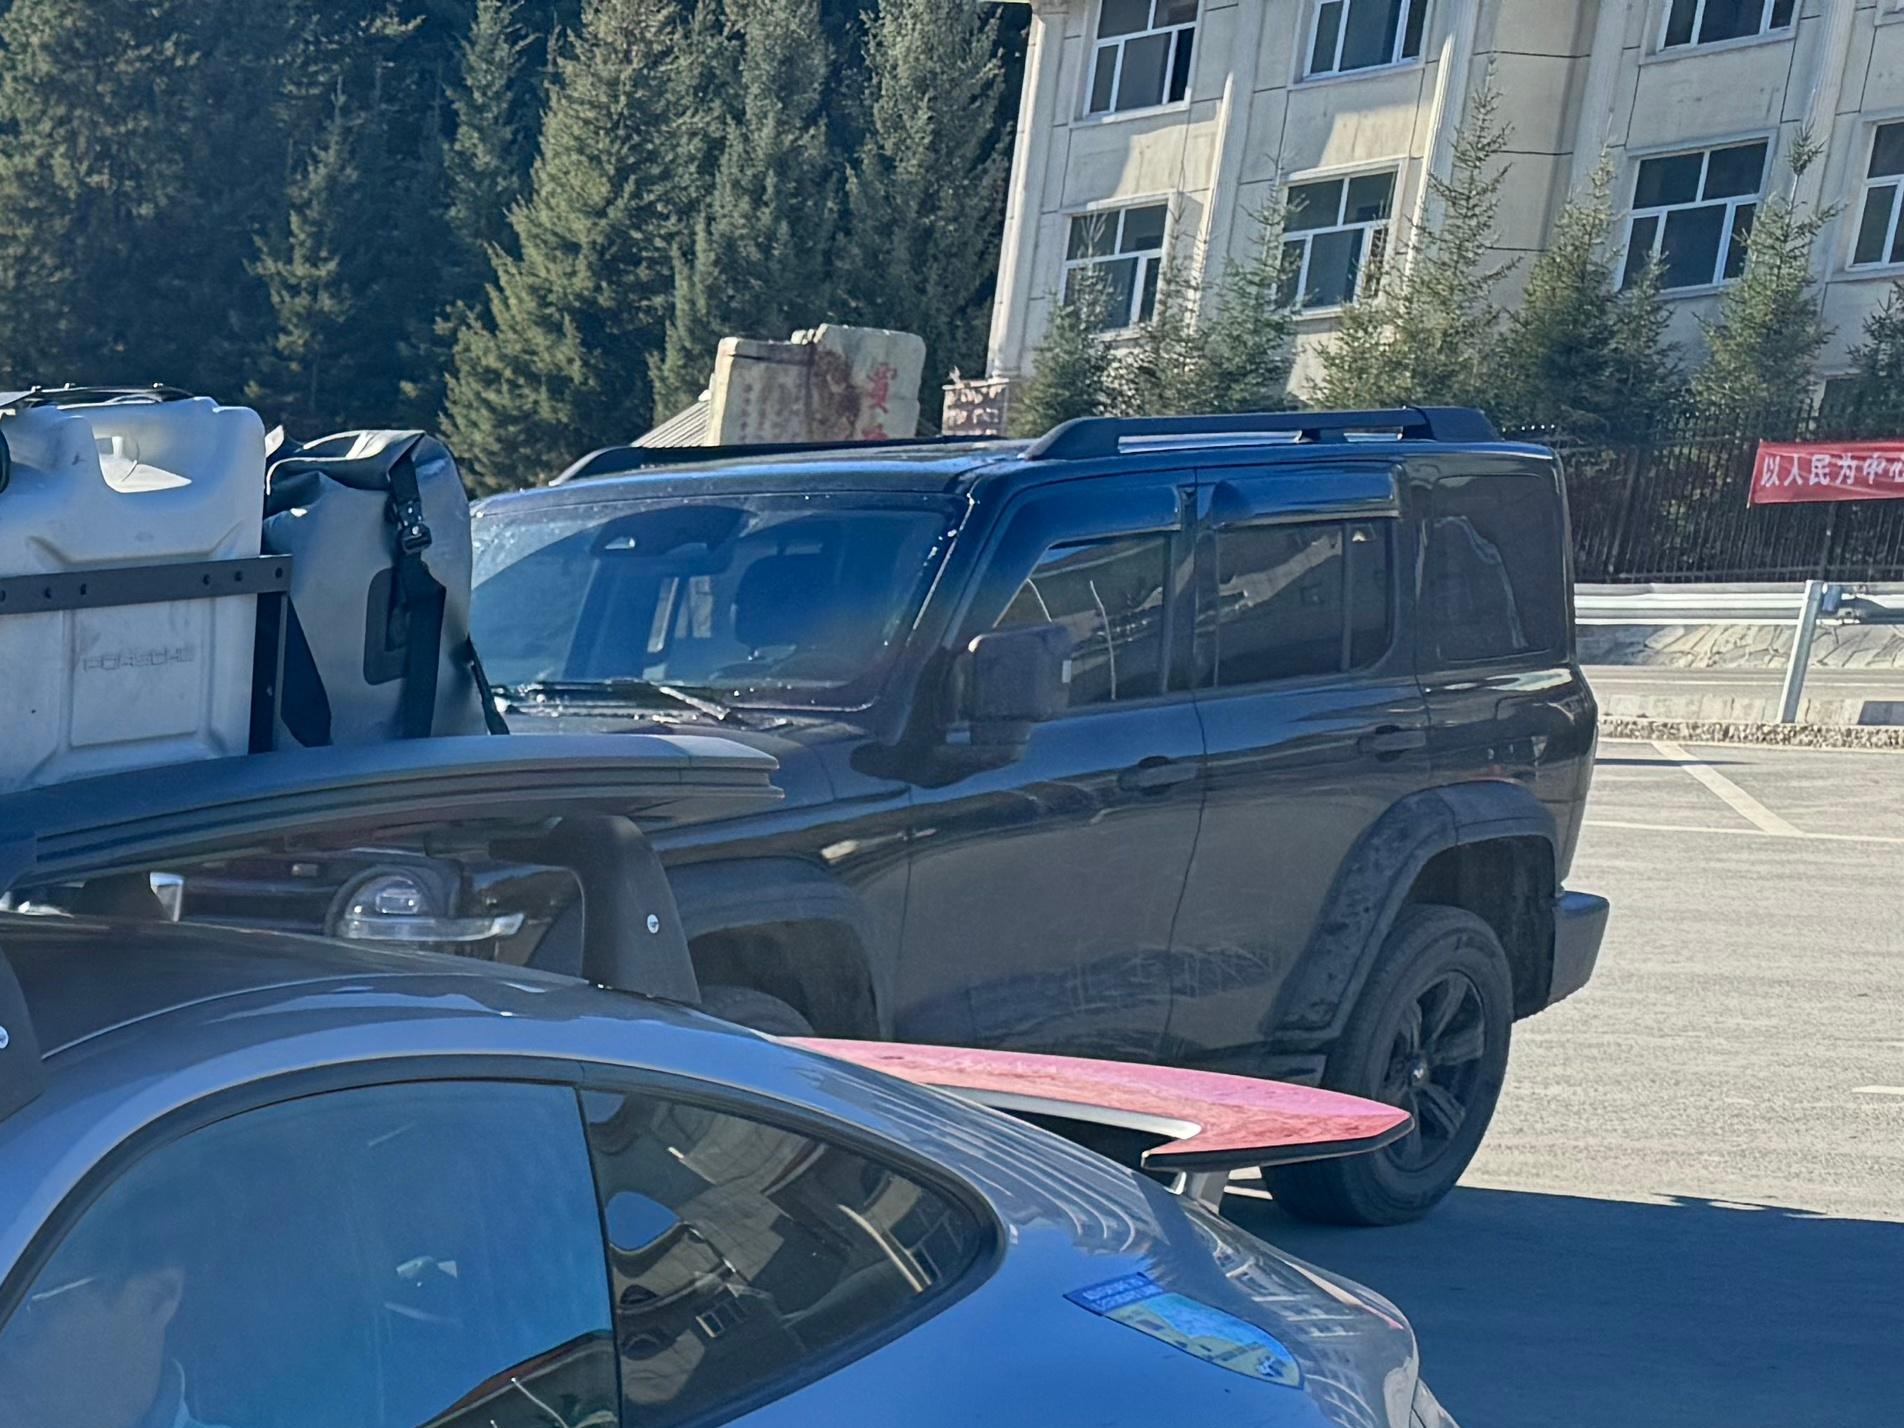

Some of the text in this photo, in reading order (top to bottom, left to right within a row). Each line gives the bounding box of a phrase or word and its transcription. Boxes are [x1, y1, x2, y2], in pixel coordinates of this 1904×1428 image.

[1761, 453, 1904, 487] 以人民为中心
